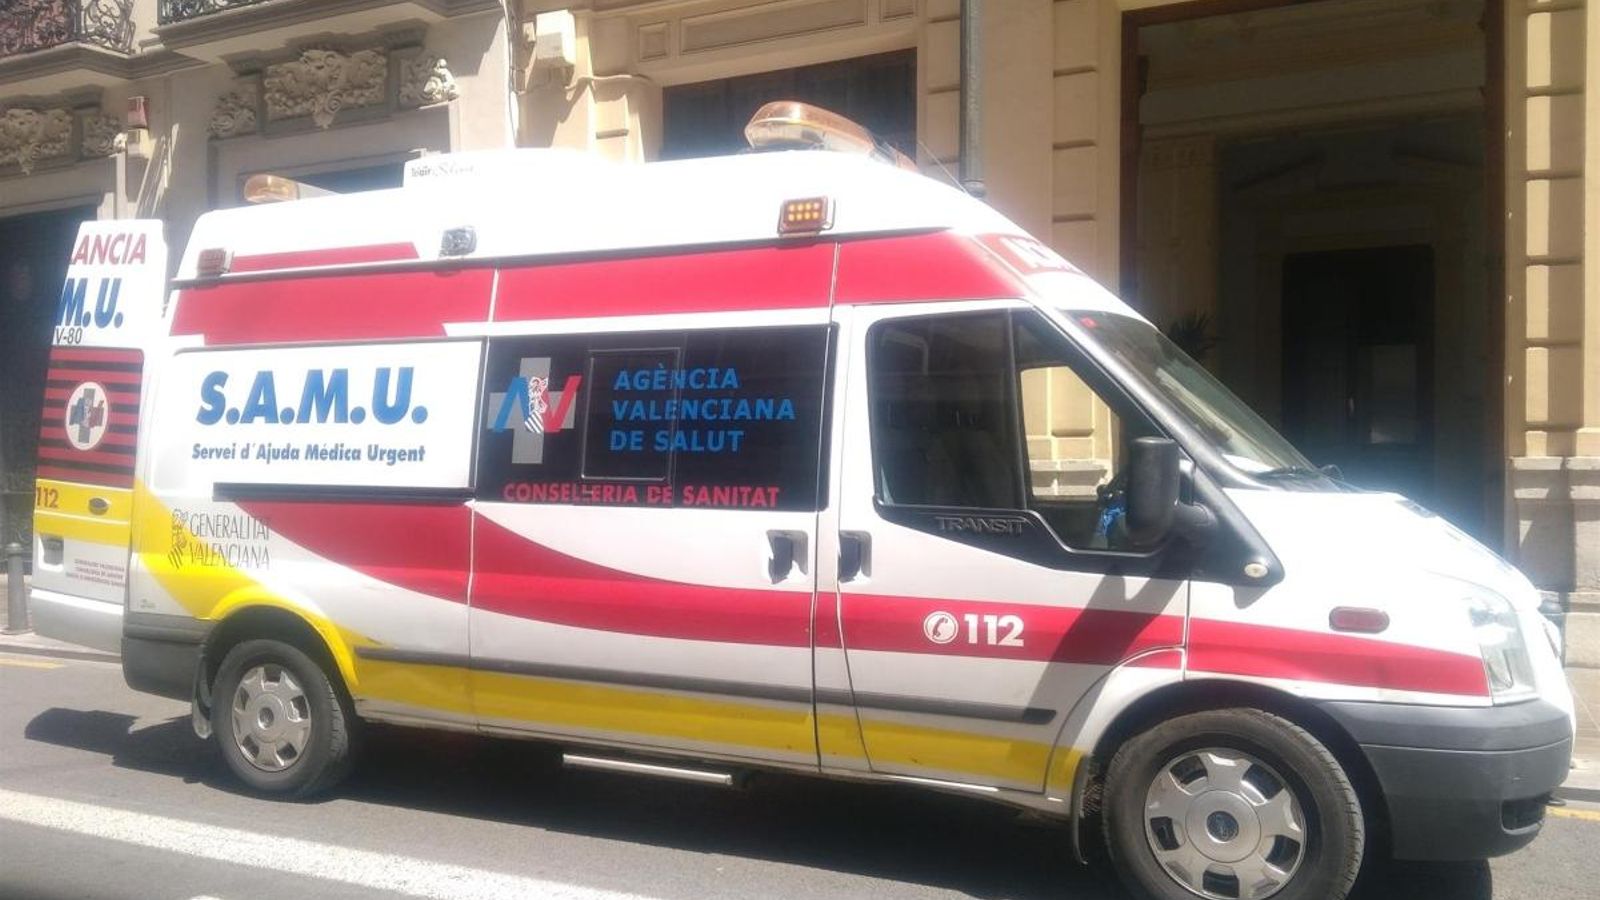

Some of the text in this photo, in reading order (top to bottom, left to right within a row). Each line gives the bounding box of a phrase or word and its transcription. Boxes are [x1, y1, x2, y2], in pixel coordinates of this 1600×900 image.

[613, 363, 741, 391] AGÈNCIA
[196, 367, 428, 426] S.A.M.U.
[611, 399, 797, 421] VALENCIANA
[609, 430, 745, 452] DE SALUT
[192, 443, 236, 460] Servei
[304, 443, 361, 461] Médica
[367, 444, 426, 466] Urgent
[503, 482, 780, 508] CONSELLERIA DE SANITAT
[936, 516, 1025, 534] TRANSIT
[189, 542, 270, 570] VALENCIANA
[964, 613, 1025, 647] 112
